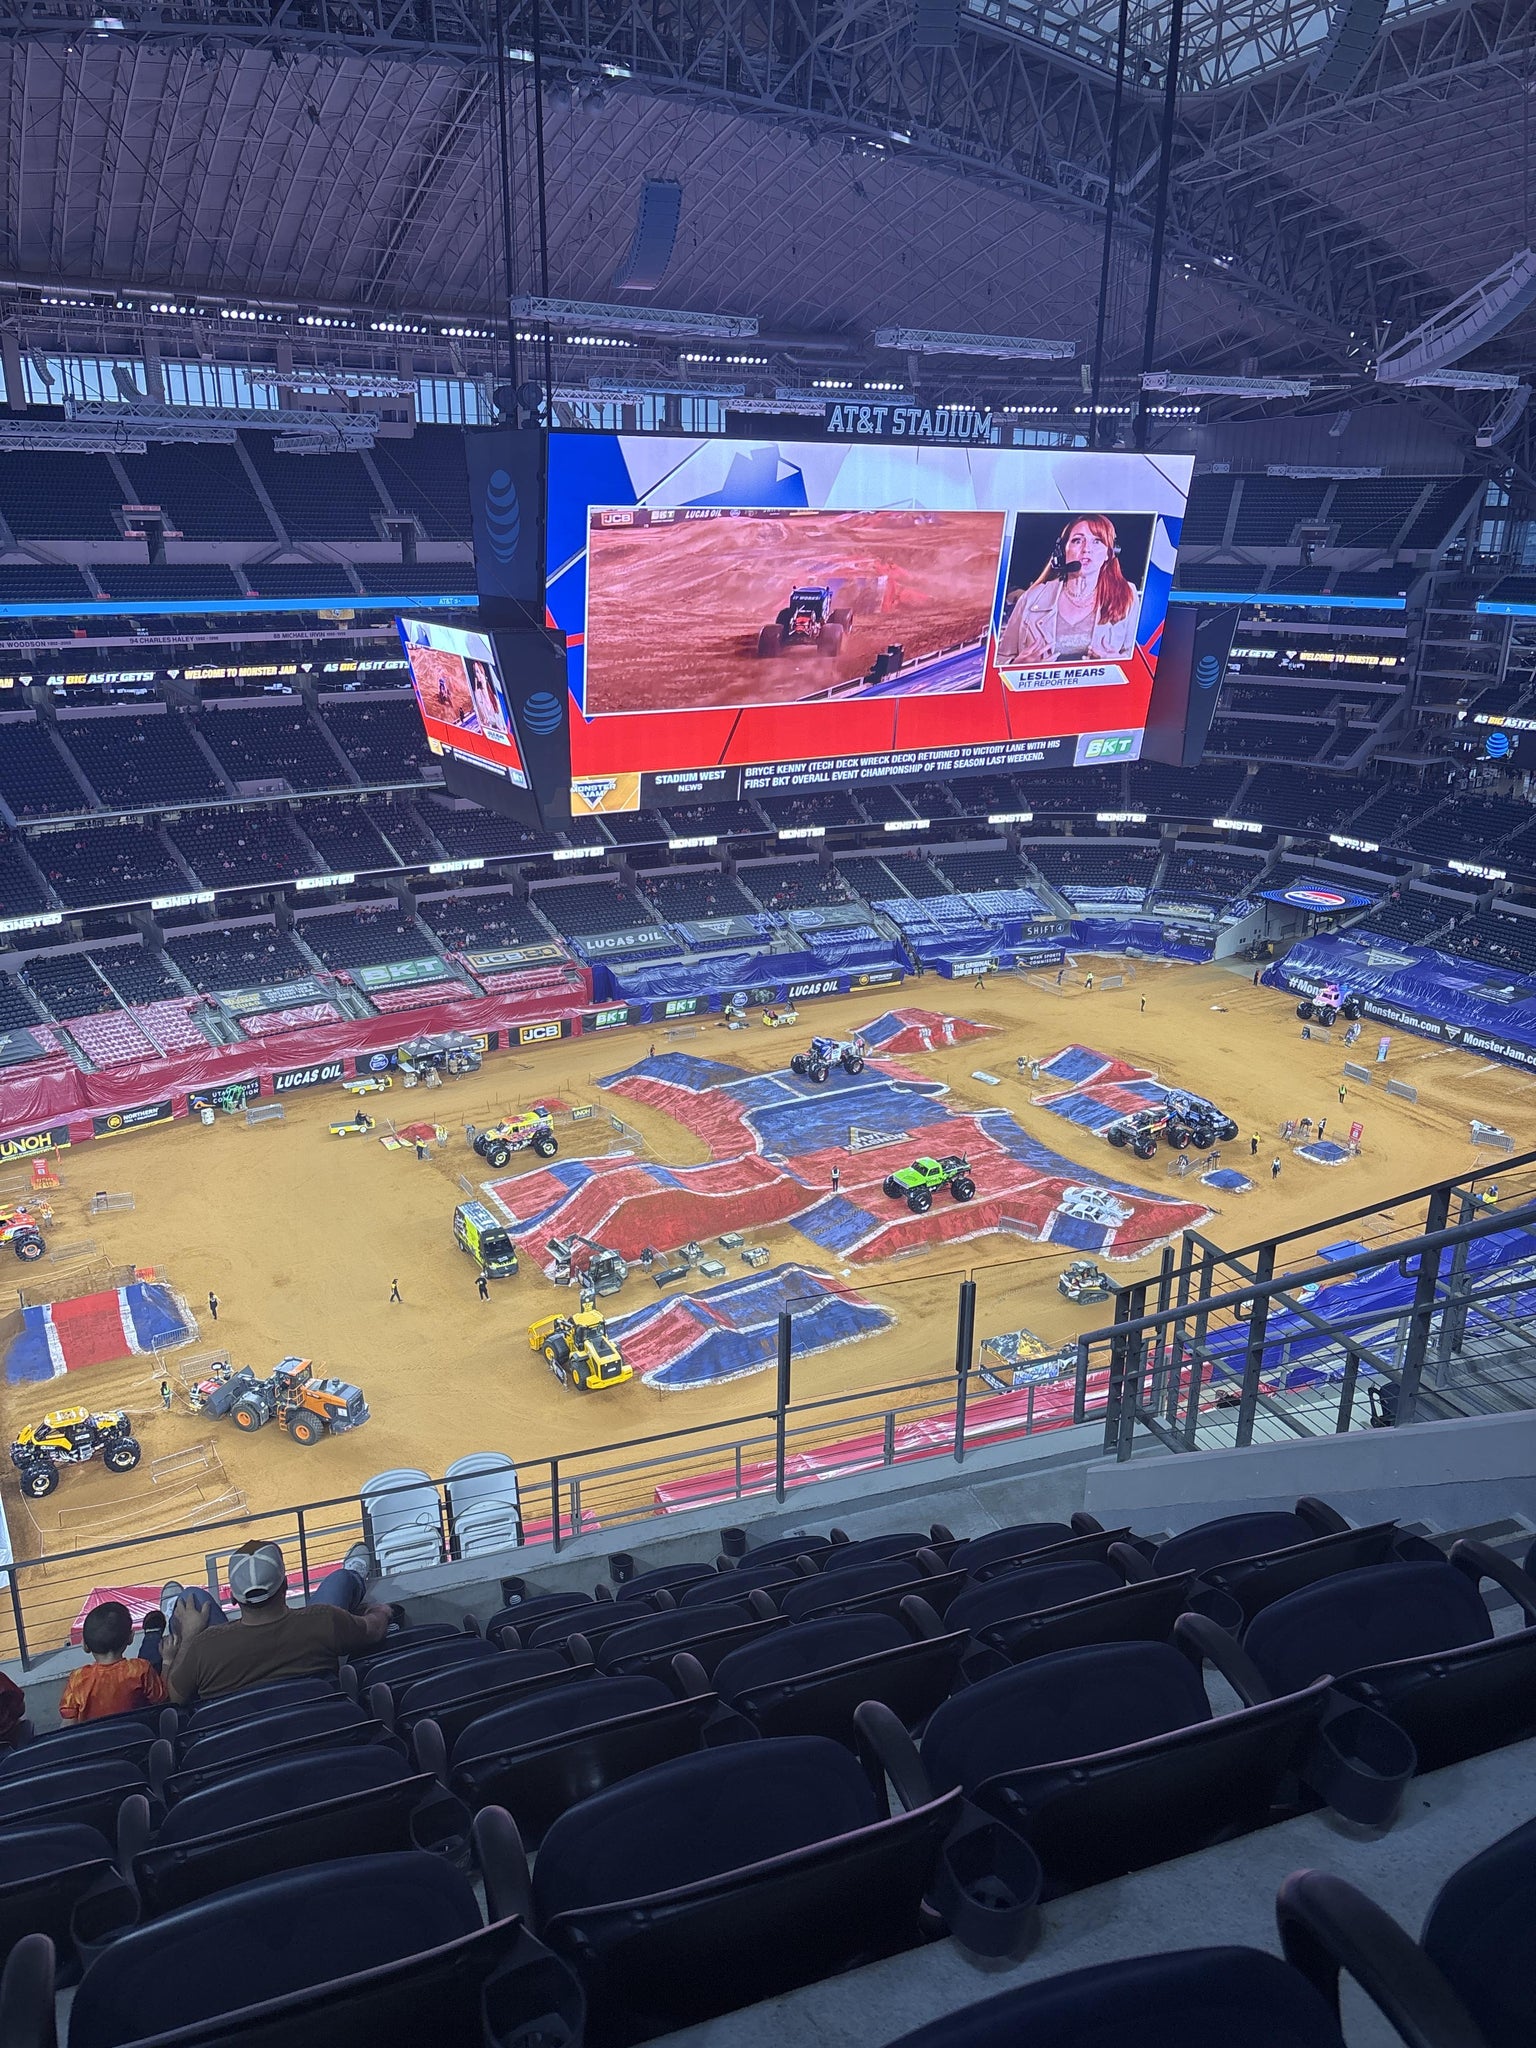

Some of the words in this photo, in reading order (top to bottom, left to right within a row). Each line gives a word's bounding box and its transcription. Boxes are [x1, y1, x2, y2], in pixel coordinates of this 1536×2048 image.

[827, 405, 888, 433] AT&T
[892, 408, 992, 438] STADIUM
[685, 510, 710, 519] LUCAS
[710, 510, 722, 518] OIL
[282, 631, 310, 639] MICHAEL
[323, 663, 339, 672] AS
[340, 662, 357, 672] BIG
[357, 661, 372, 671] AS
[372, 661, 384, 670] IT
[384, 660, 409, 670] GETS
[1300, 652, 1335, 662] WELCOME
[1335, 654, 1345, 662] TO
[1344, 655, 1379, 665] MONSTER
[1379, 657, 1397, 666] JAM
[46, 675, 64, 686] AS
[65, 674, 87, 685] BIG
[87, 674, 104, 684] AS
[104, 673, 118, 684] IT
[118, 672, 156, 682] GETS!
[184, 669, 226, 679] WELCOME
[227, 668, 238, 678] TO
[238, 665, 277, 676] MONSTER
[279, 665, 297, 675] JAM
[1020, 670, 1061, 681] LESLIE
[1064, 668, 1106, 678] MEARS
[0, 678, 14, 688] AM
[1018, 681, 1032, 689] PIT
[1034, 678, 1079, 687] REPORTER
[1474, 714, 1488, 725] AS
[1487, 716, 1503, 726] BIG
[1503, 717, 1518, 728] AS
[1517, 718, 1528, 729] IT
[1085, 739, 1131, 758] BKT
[745, 765, 775, 777] BRYCE
[777, 763, 807, 774] KENNY
[808, 760, 834, 772] (TECH
[835, 758, 859, 769] DECK
[861, 756, 890, 767] WRECK
[891, 753, 916, 765] DECK)
[918, 749, 960, 761] RETURNED
[962, 748, 971, 757] TO
[973, 745, 1005, 756] VICTORY
[1004, 742, 1026, 753] LANE
[1027, 741, 1046, 751] WITH
[1047, 740, 1060, 749] HIS
[655, 772, 698, 785] STADIUM
[699, 769, 726, 782] WEST
[744, 777, 770, 789] FIRST
[772, 775, 790, 787] BKT
[792, 772, 830, 784] OVERALL
[831, 770, 859, 781] EVENT
[861, 764, 922, 778] CHAMPIONSHIP
[924, 763, 935, 772] OF
[936, 761, 951, 771] THE
[954, 758, 984, 769] SEASON
[986, 756, 1005, 766] LAST
[1007, 752, 1045, 763] WEEKEND.
[570, 782, 616, 793] MONSTER
[582, 789, 605, 798] JAM
[678, 783, 703, 793] NEWS
[586, 935, 635, 950] LUCAS
[638, 932, 663, 943] OIL
[475, 951, 524, 965] JCB
[364, 961, 439, 981] BKT
[953, 968, 972, 977] SUPER
[954, 962, 965, 971] THE
[965, 960, 990, 969] ORIGINAL
[789, 981, 821, 998] LUCAS
[822, 981, 838, 993] OIL
[665, 1000, 696, 1014] BKT
[595, 1009, 628, 1025] BKT
[1364, 1001, 1441, 1034] MonsterJam.com
[523, 1027, 558, 1041] JCB
[1463, 1033, 1536, 1066] MonsterJam.co
[276, 1069, 319, 1090] LUCAS
[321, 1064, 342, 1080] OIL
[123, 1107, 159, 1120] NORTHERN
[1, 1131, 52, 1156] UNOH
